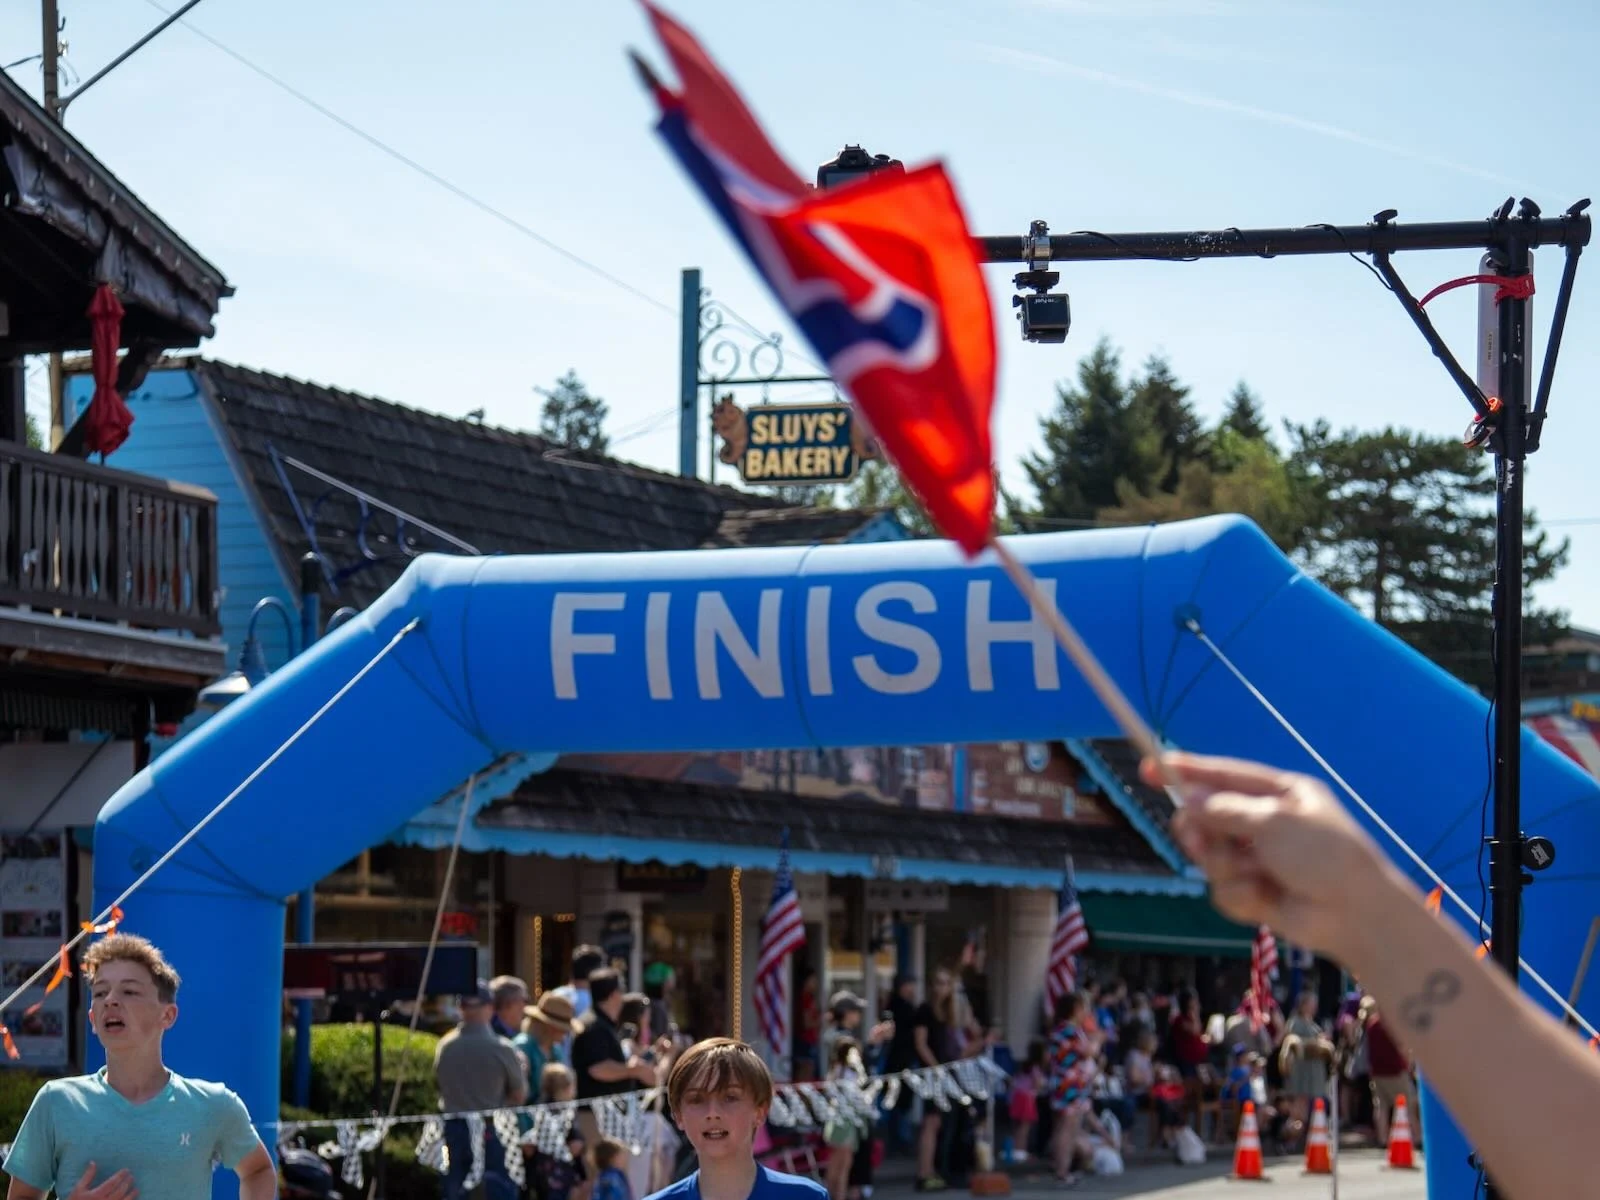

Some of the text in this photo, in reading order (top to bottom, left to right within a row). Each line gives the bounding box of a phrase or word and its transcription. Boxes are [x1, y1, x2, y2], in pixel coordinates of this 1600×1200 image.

[751, 412, 847, 444] SLUYS'
[746, 446, 850, 478] BAKERY
[551, 579, 1060, 699] FINISH
